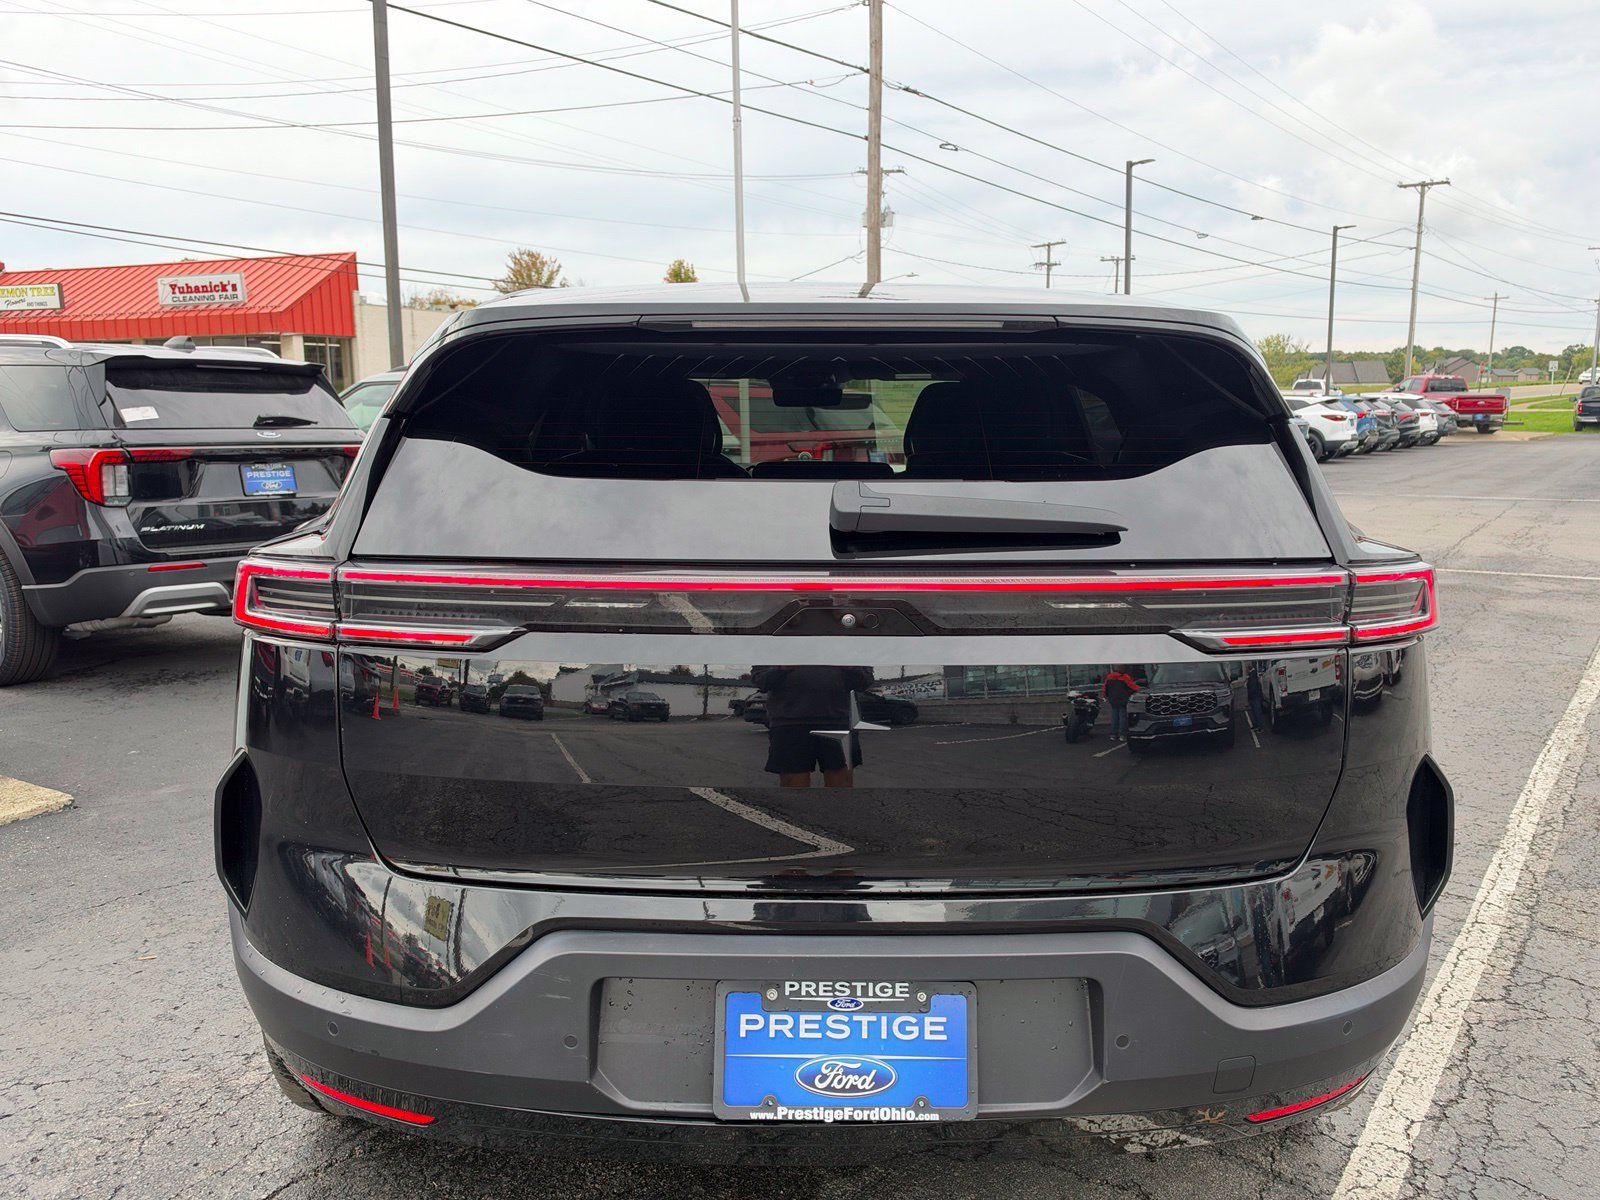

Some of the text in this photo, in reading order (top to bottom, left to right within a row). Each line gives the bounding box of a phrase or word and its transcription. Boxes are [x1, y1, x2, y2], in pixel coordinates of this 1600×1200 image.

[30, 286, 56, 297] TREE
[169, 281, 238, 295] Yuhanick's
[172, 293, 239, 303] CLEANING FAIR
[246, 470, 292, 478] PRESTIGE
[140, 523, 206, 533] PLATINUM
[784, 981, 910, 998] PRESTIGE
[834, 999, 857, 1008] Ford
[739, 1013, 948, 1041] PRESTIGE
[814, 1060, 877, 1090] Ford
[749, 1106, 940, 1122] www.PrestigeFordOhio.com
